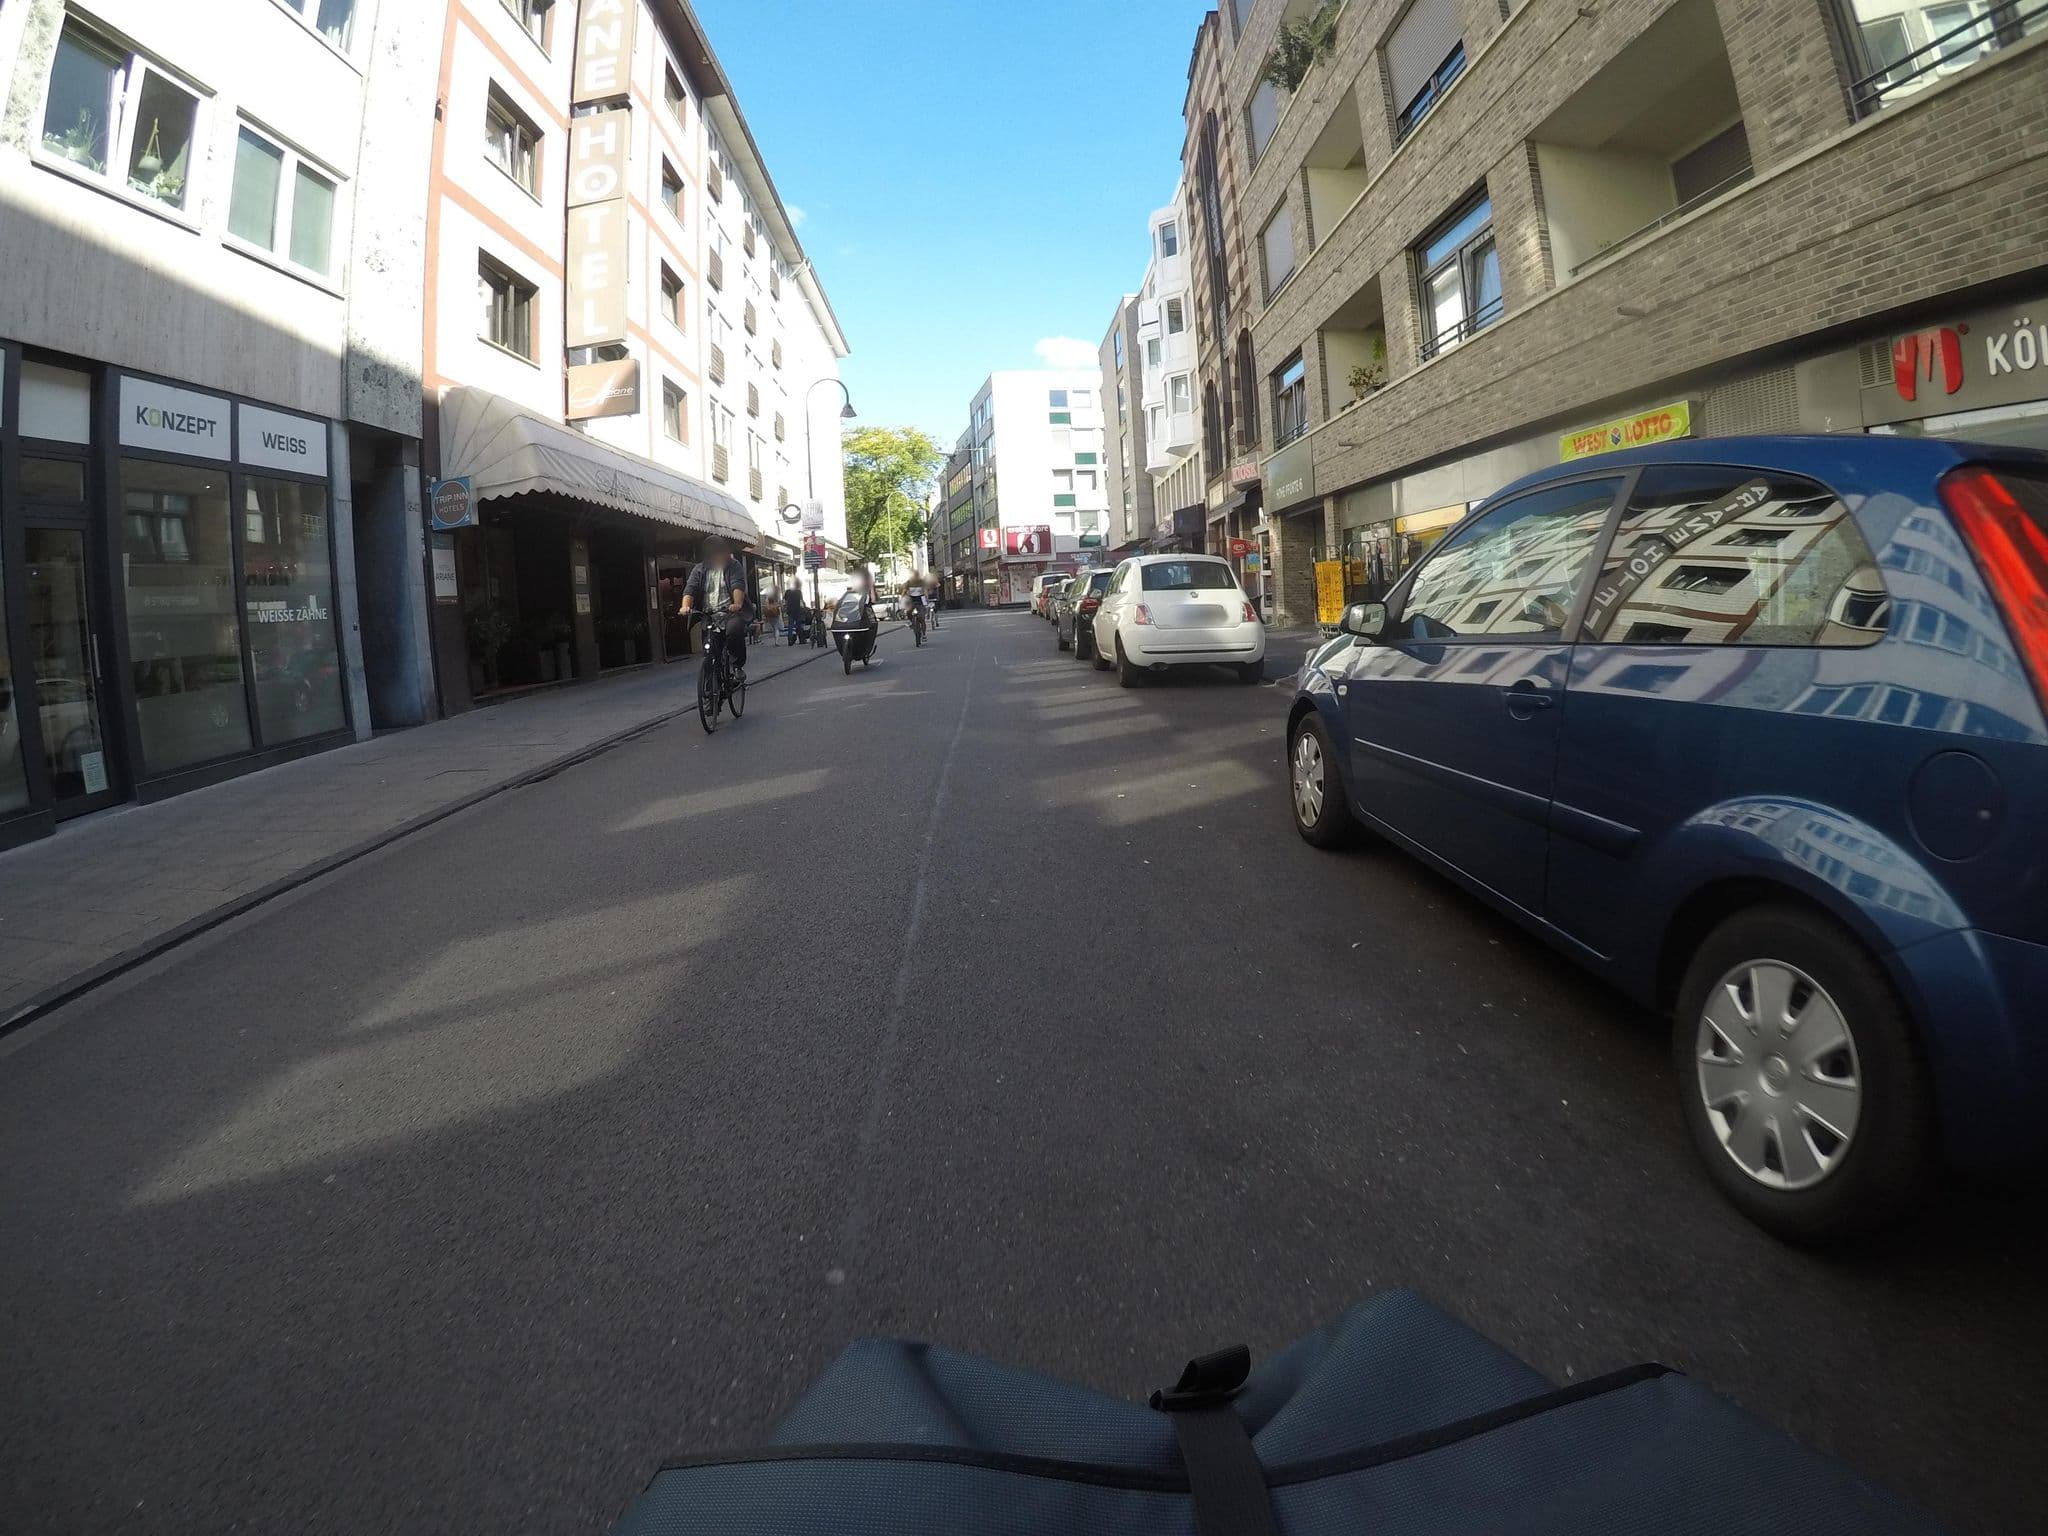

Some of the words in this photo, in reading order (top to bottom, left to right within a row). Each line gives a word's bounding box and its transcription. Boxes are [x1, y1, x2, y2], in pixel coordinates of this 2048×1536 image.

[574, 121, 618, 337] HOTEL
[136, 405, 217, 437] KONZEPT
[262, 431, 307, 455] WEISS
[1572, 430, 1608, 453] WEST
[1624, 412, 1673, 443] LOTTO
[435, 494, 453, 505] TRIP
[453, 491, 469, 502] INN
[439, 503, 465, 514] HOTELS
[258, 608, 295, 623] WEISSE
[296, 606, 328, 621] ZÄHNE
